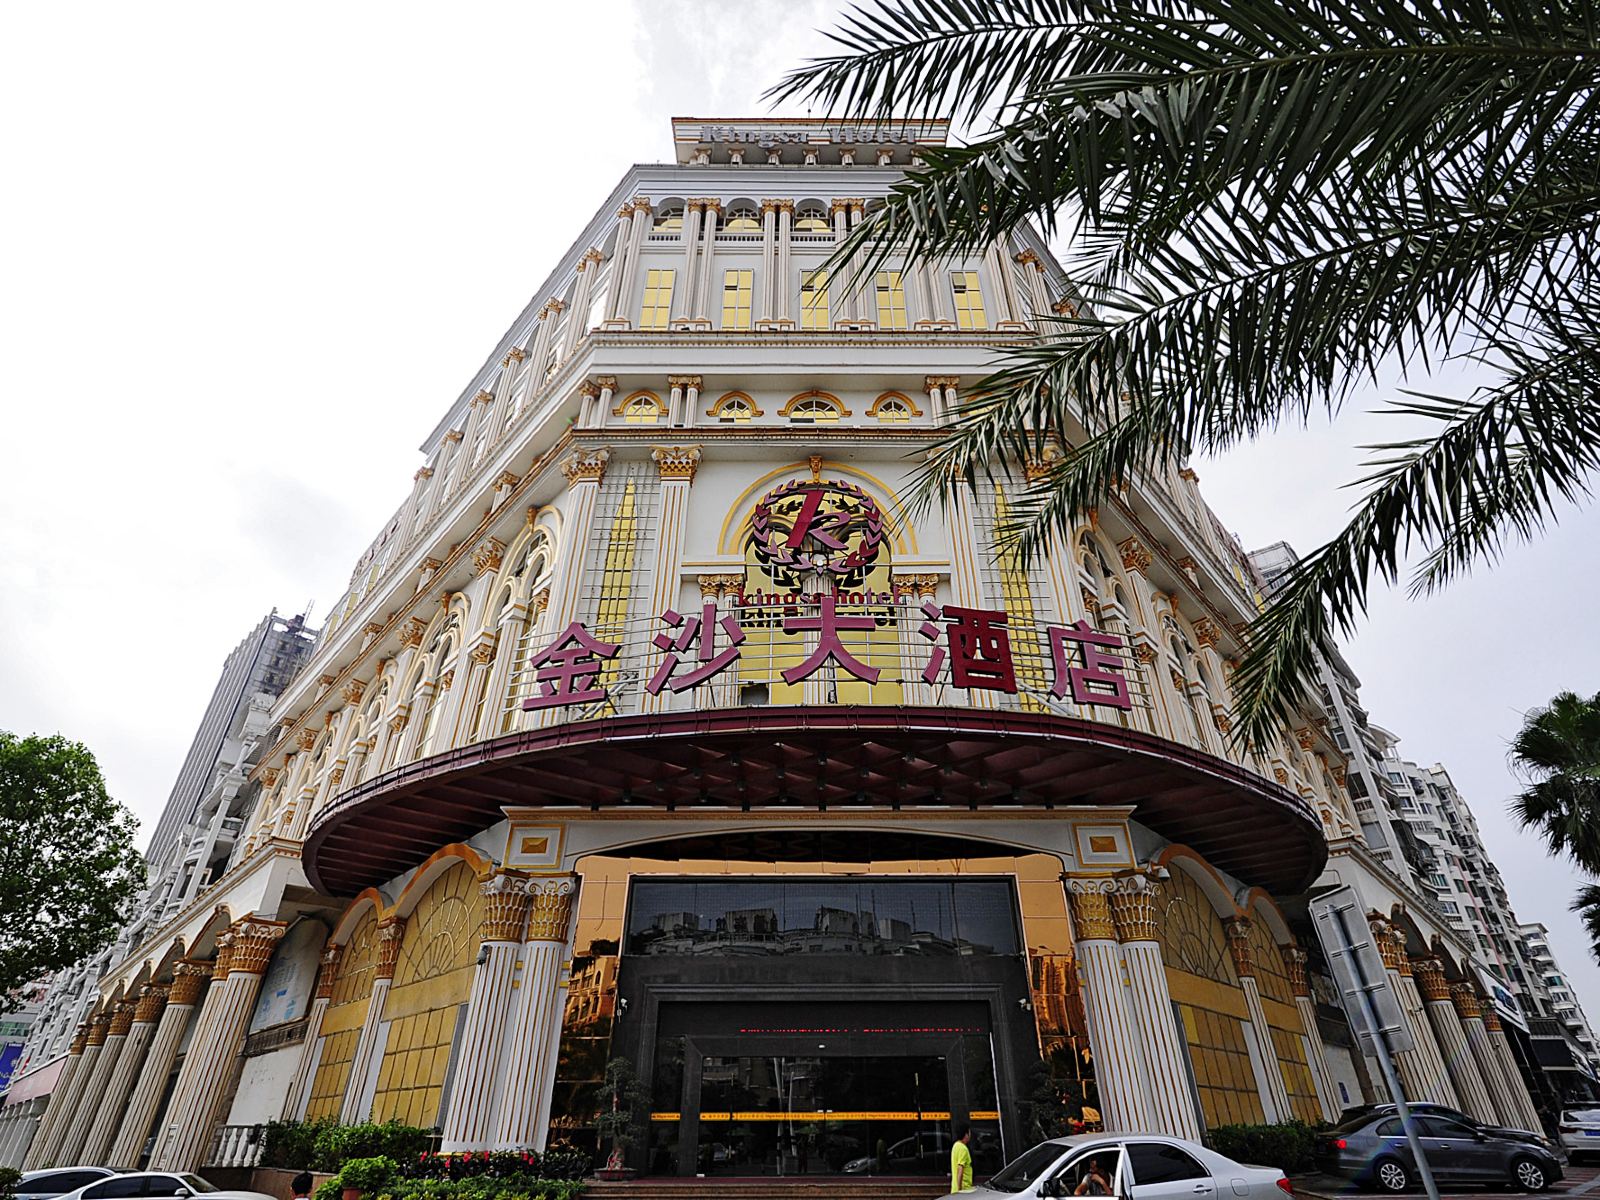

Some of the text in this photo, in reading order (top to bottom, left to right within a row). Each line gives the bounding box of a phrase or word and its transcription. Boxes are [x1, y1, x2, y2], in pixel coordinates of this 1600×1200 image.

[827, 126, 917, 144] Hotel
[831, 582, 901, 606] hotel
[522, 597, 1133, 713] 金沙大酒店
